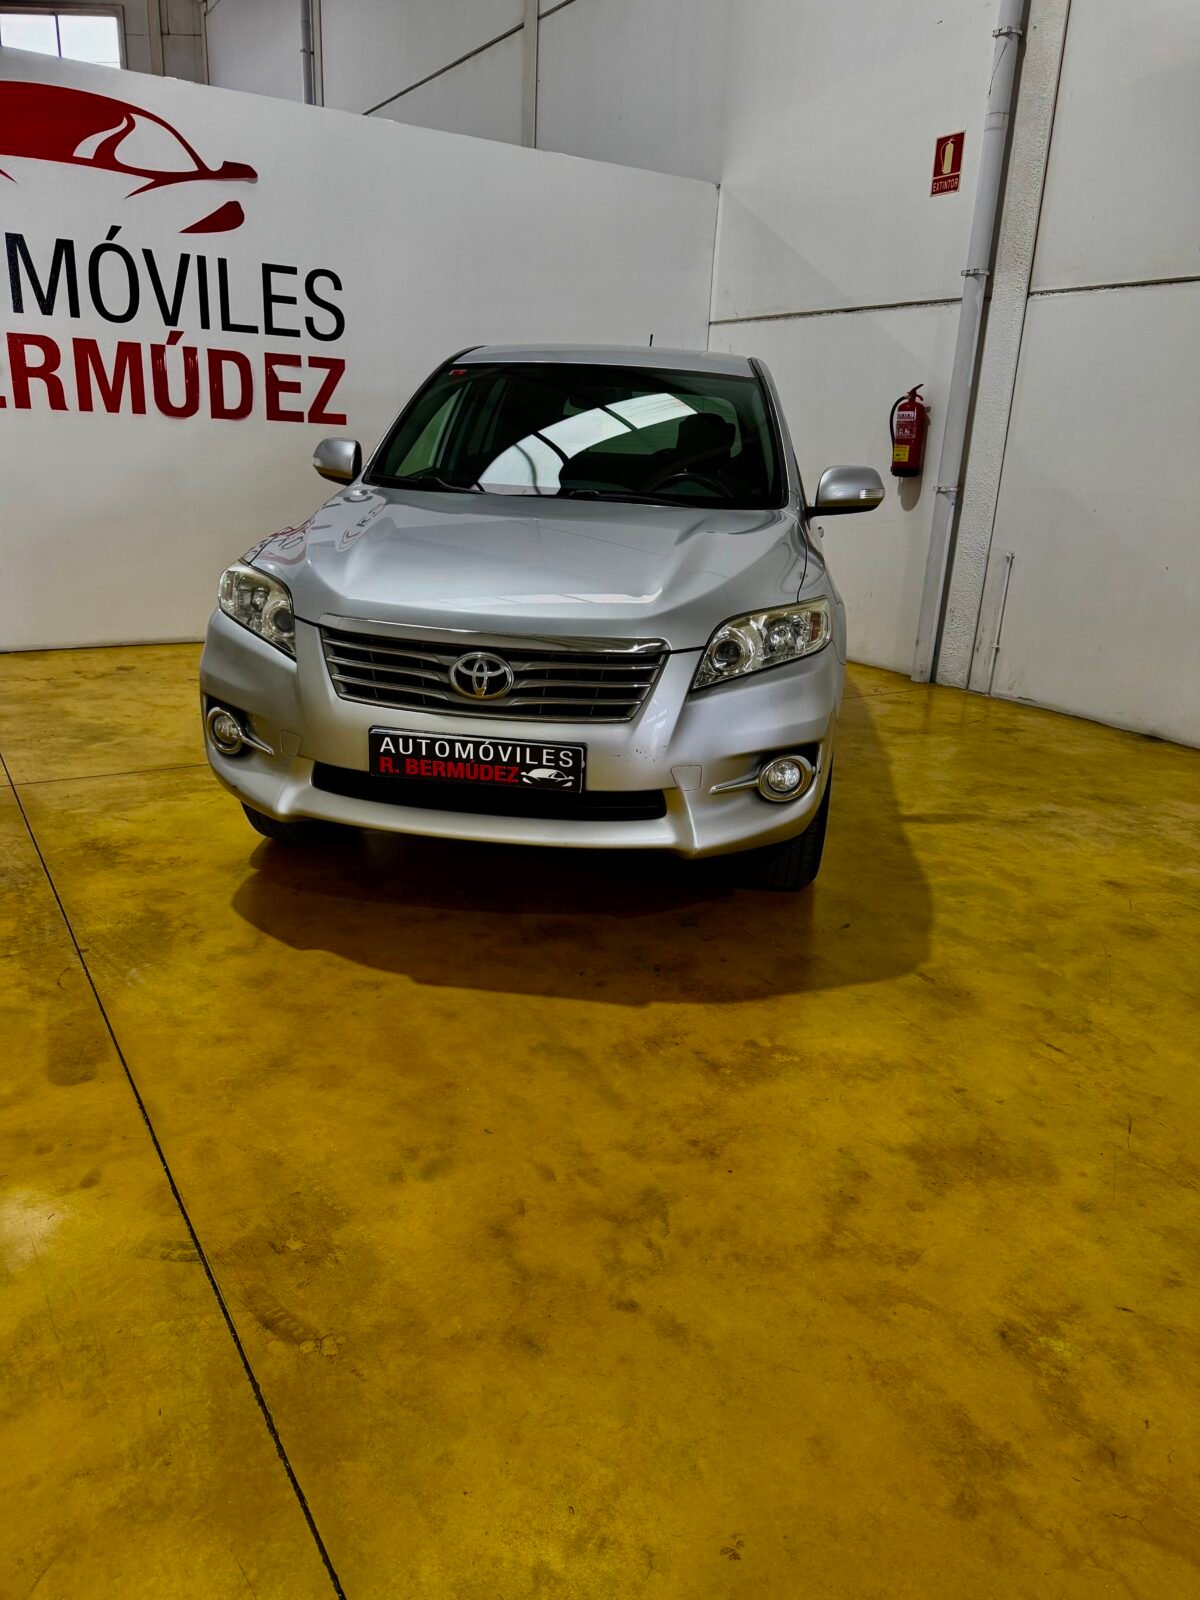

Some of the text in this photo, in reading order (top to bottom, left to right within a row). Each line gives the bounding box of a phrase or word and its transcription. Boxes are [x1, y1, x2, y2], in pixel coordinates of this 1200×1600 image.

[933, 178, 959, 192] EXTINTOR
[0, 330, 347, 426] RMÚDEZ
[379, 736, 574, 768] AUTOMÓVILES
[379, 756, 520, 784] R. BERMÚDEZ
